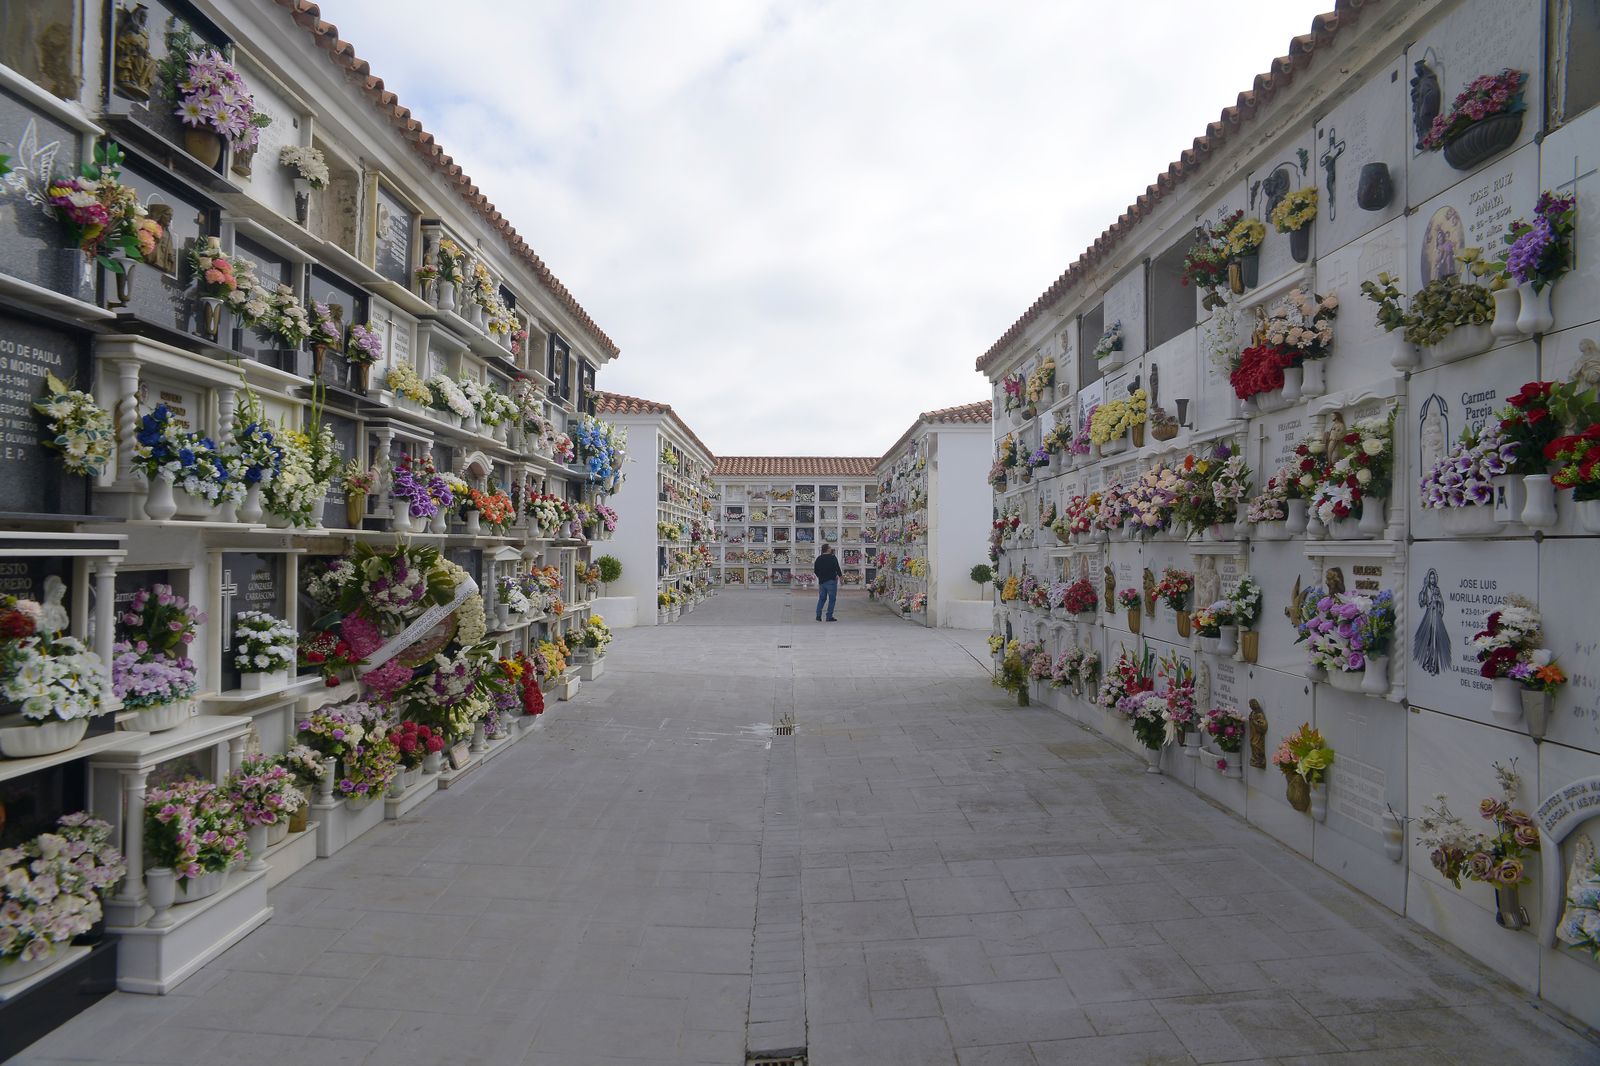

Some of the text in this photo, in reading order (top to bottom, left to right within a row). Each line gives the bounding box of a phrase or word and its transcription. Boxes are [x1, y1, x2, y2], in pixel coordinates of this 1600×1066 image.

[1469, 173, 1514, 206] JOSE RUIZ
[1476, 194, 1504, 217] ANAYA
[17, 344, 31, 358] DE
[32, 348, 62, 366] PAULA
[10, 359, 50, 378] MORENO
[1461, 389, 1496, 406] Carmen
[1465, 404, 1493, 420] Pareja
[12, 421, 38, 432] NIETOS
[1472, 419, 1486, 434] Gil
[1459, 579, 1497, 590] JOSE LUIS
[1449, 593, 1507, 605] MORILLA ROJAS
[400, 616, 428, 641] RECUERDO
[1453, 664, 1459, 672] LA
[1460, 679, 1493, 691] DEL SEÑOR
